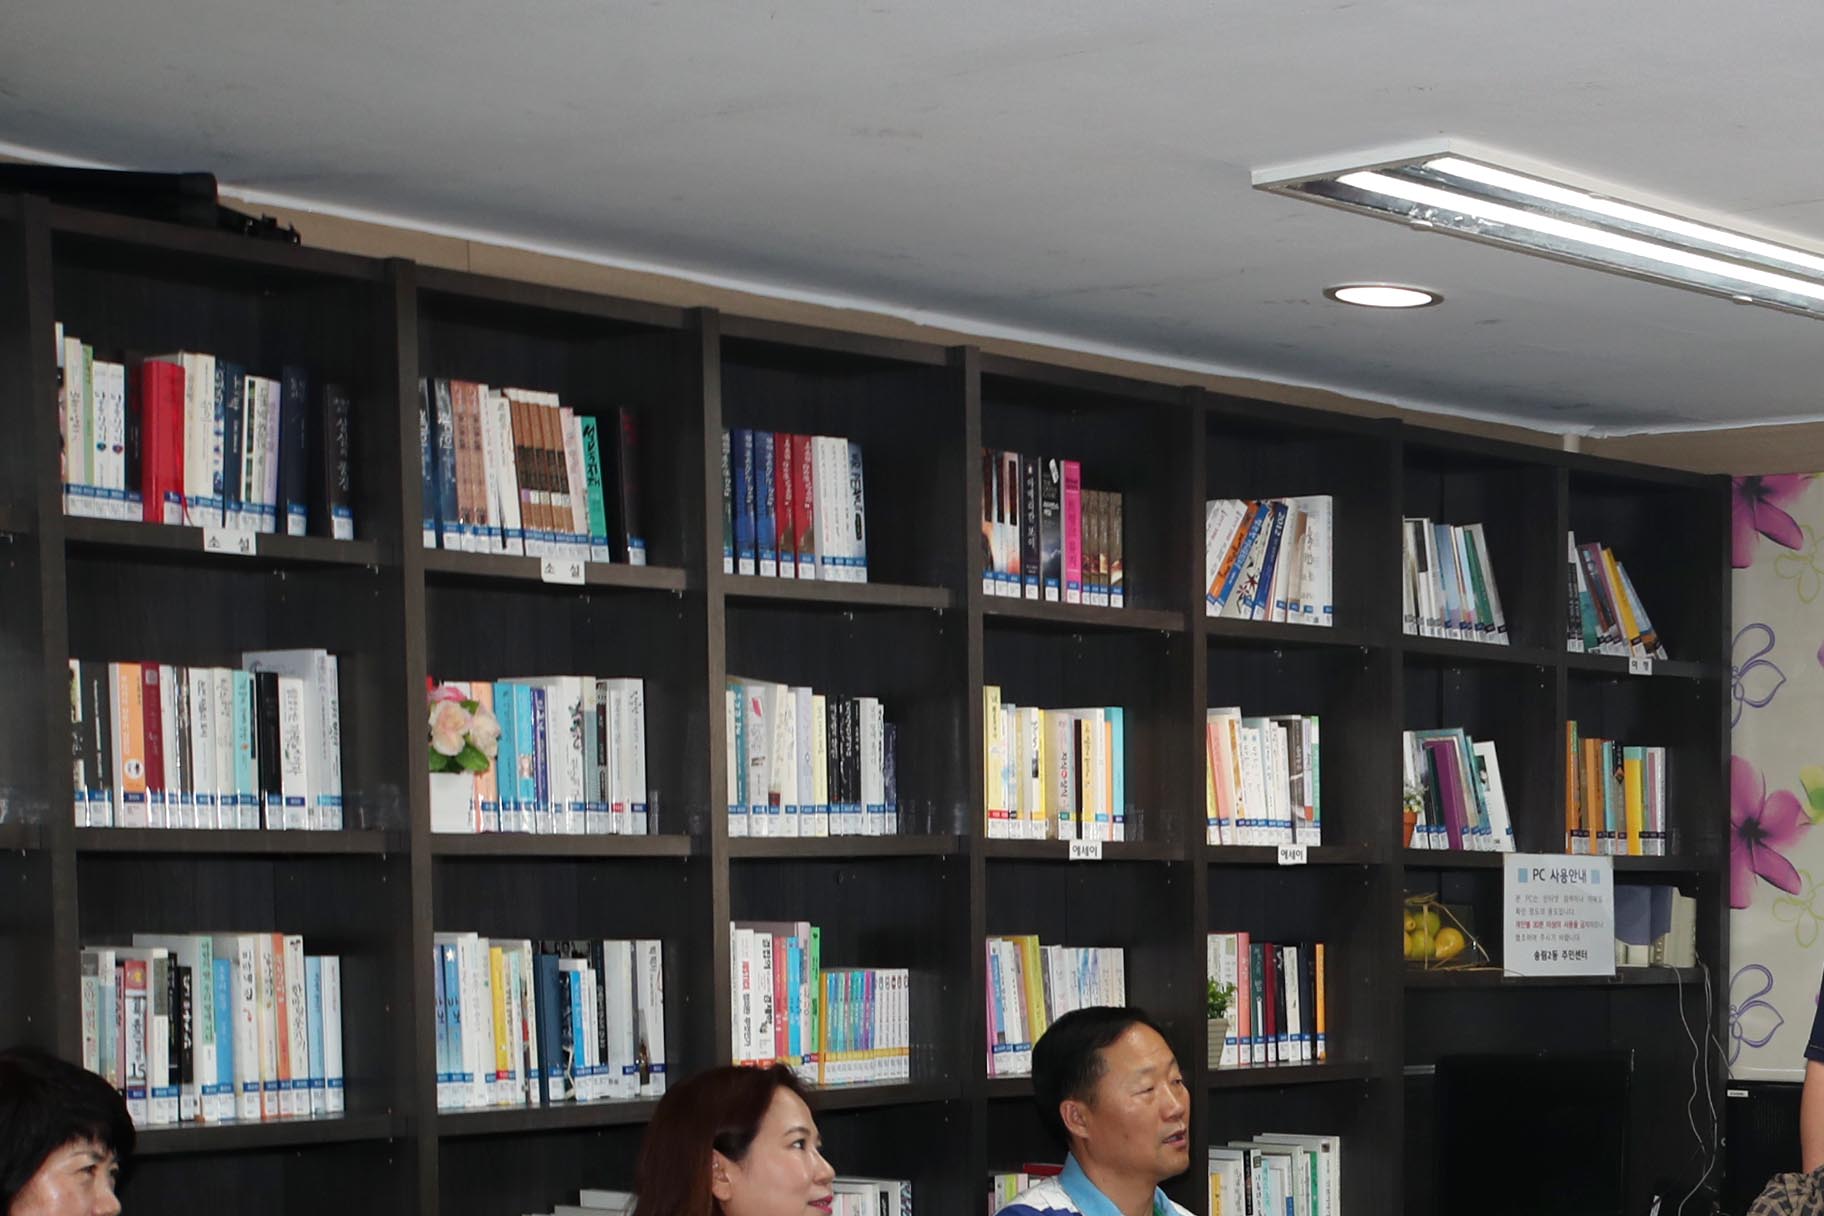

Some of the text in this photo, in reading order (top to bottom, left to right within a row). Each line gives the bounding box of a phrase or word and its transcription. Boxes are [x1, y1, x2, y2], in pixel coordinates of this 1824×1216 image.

[1072, 846, 1098, 857] 에세이
[1280, 848, 1304, 860] 에세이
[1532, 868, 1587, 884] PC 사용안내
[1561, 949, 1588, 960] 주민센터
